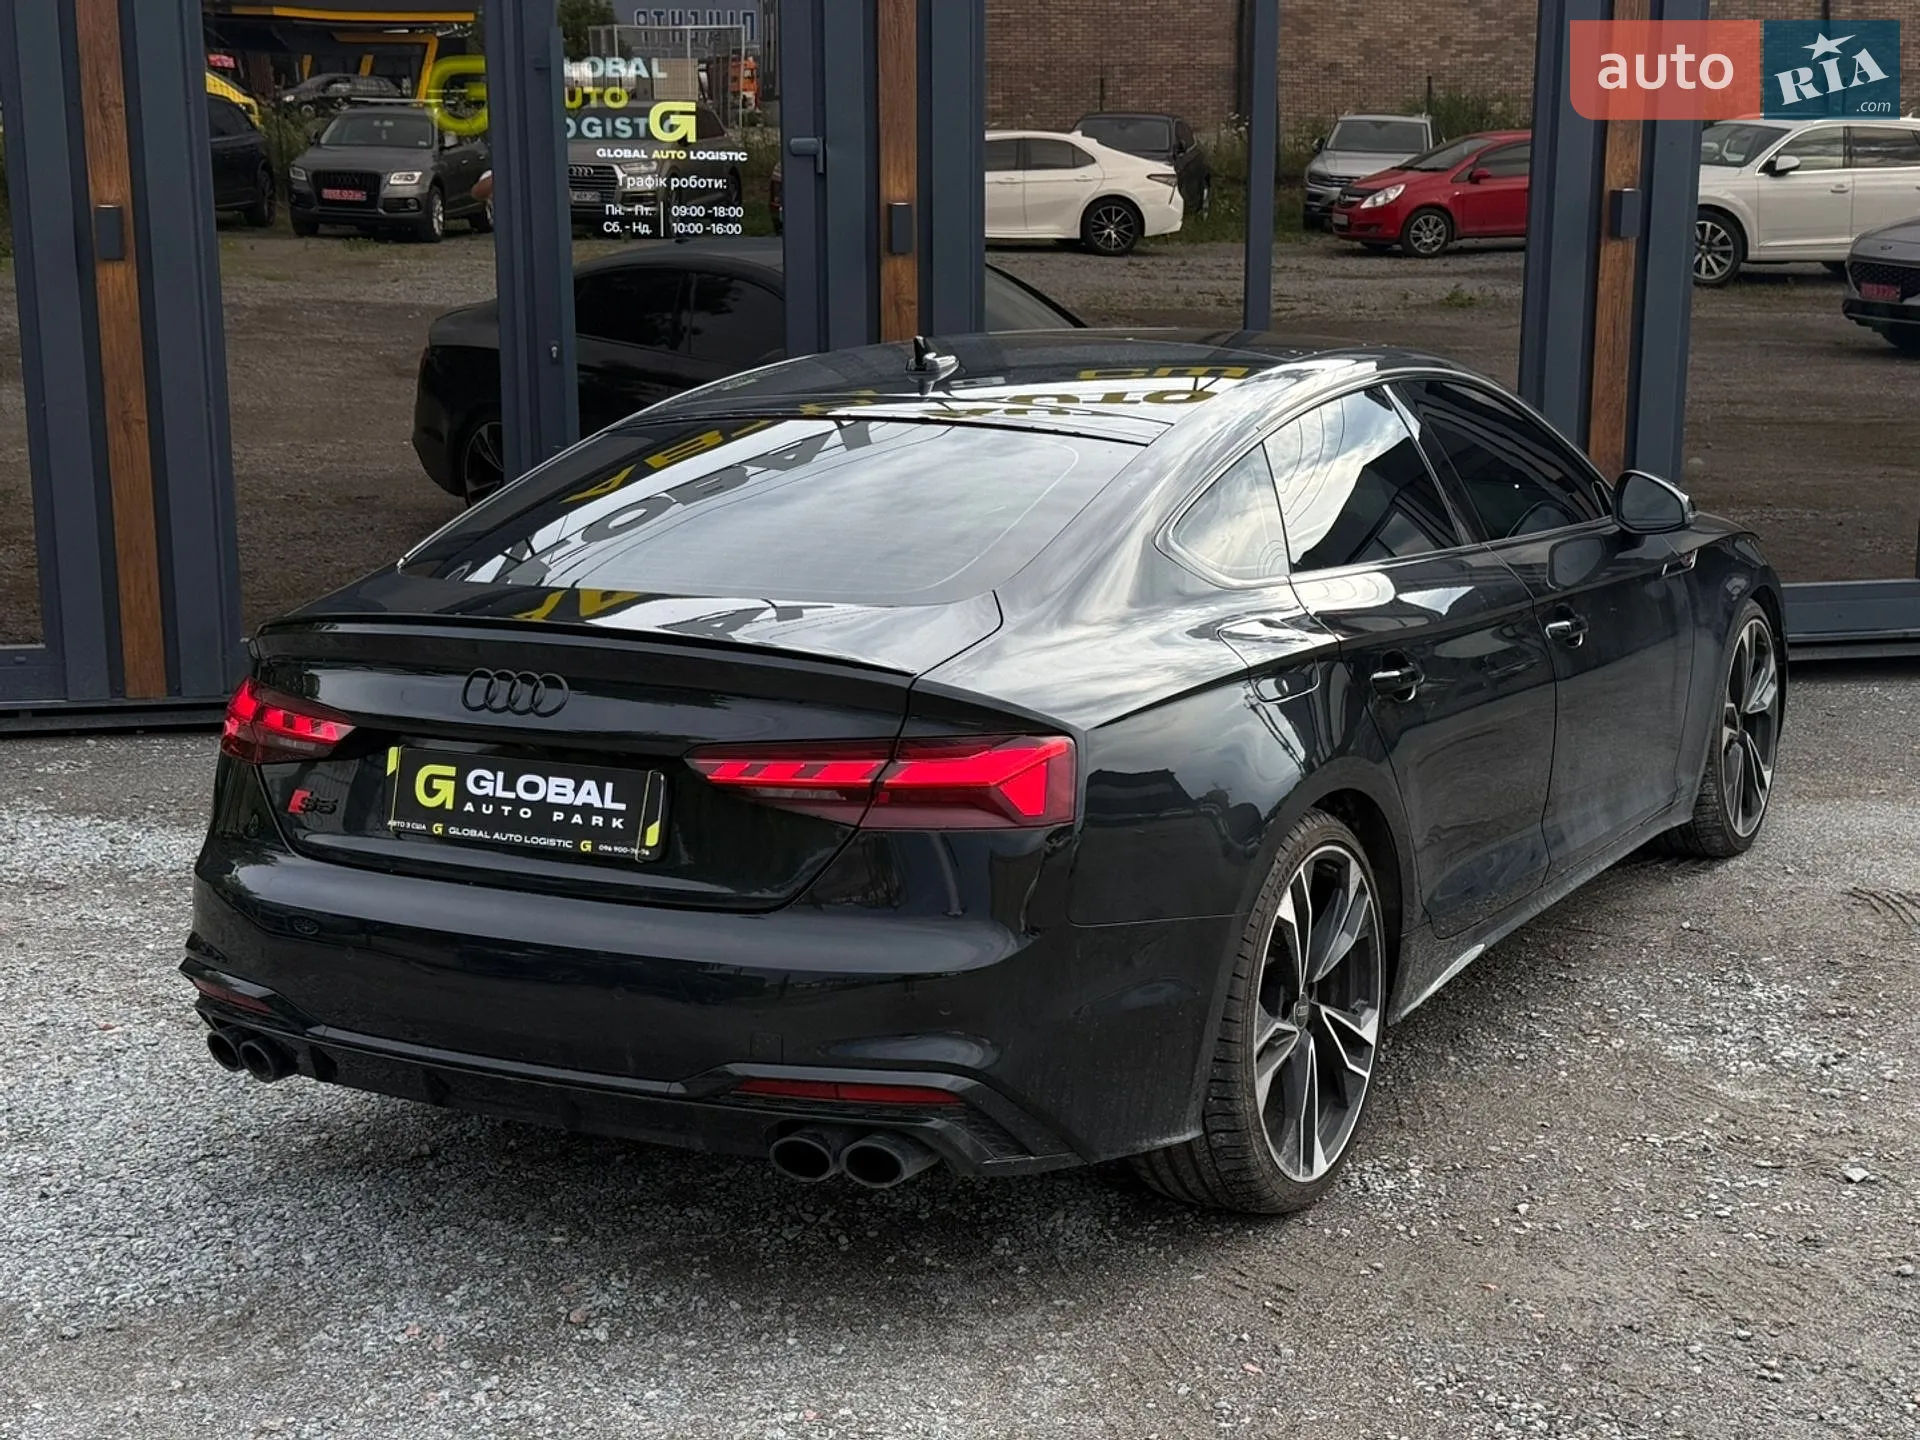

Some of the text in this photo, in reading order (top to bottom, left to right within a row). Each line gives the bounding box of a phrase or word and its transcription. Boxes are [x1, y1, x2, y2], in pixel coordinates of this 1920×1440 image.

[596, 148, 748, 161] GLOBAL AUTO LOGISTIC
[616, 174, 727, 190] Графік роботи:
[671, 205, 706, 217] 09:00
[672, 223, 704, 234] 10:00
[466, 769, 627, 811] GLOBAL
[463, 802, 625, 829] AUTO PARK
[448, 826, 491, 839] GLOBAL
[492, 832, 522, 842] AUTO
[524, 835, 573, 848] LOGISTIC
